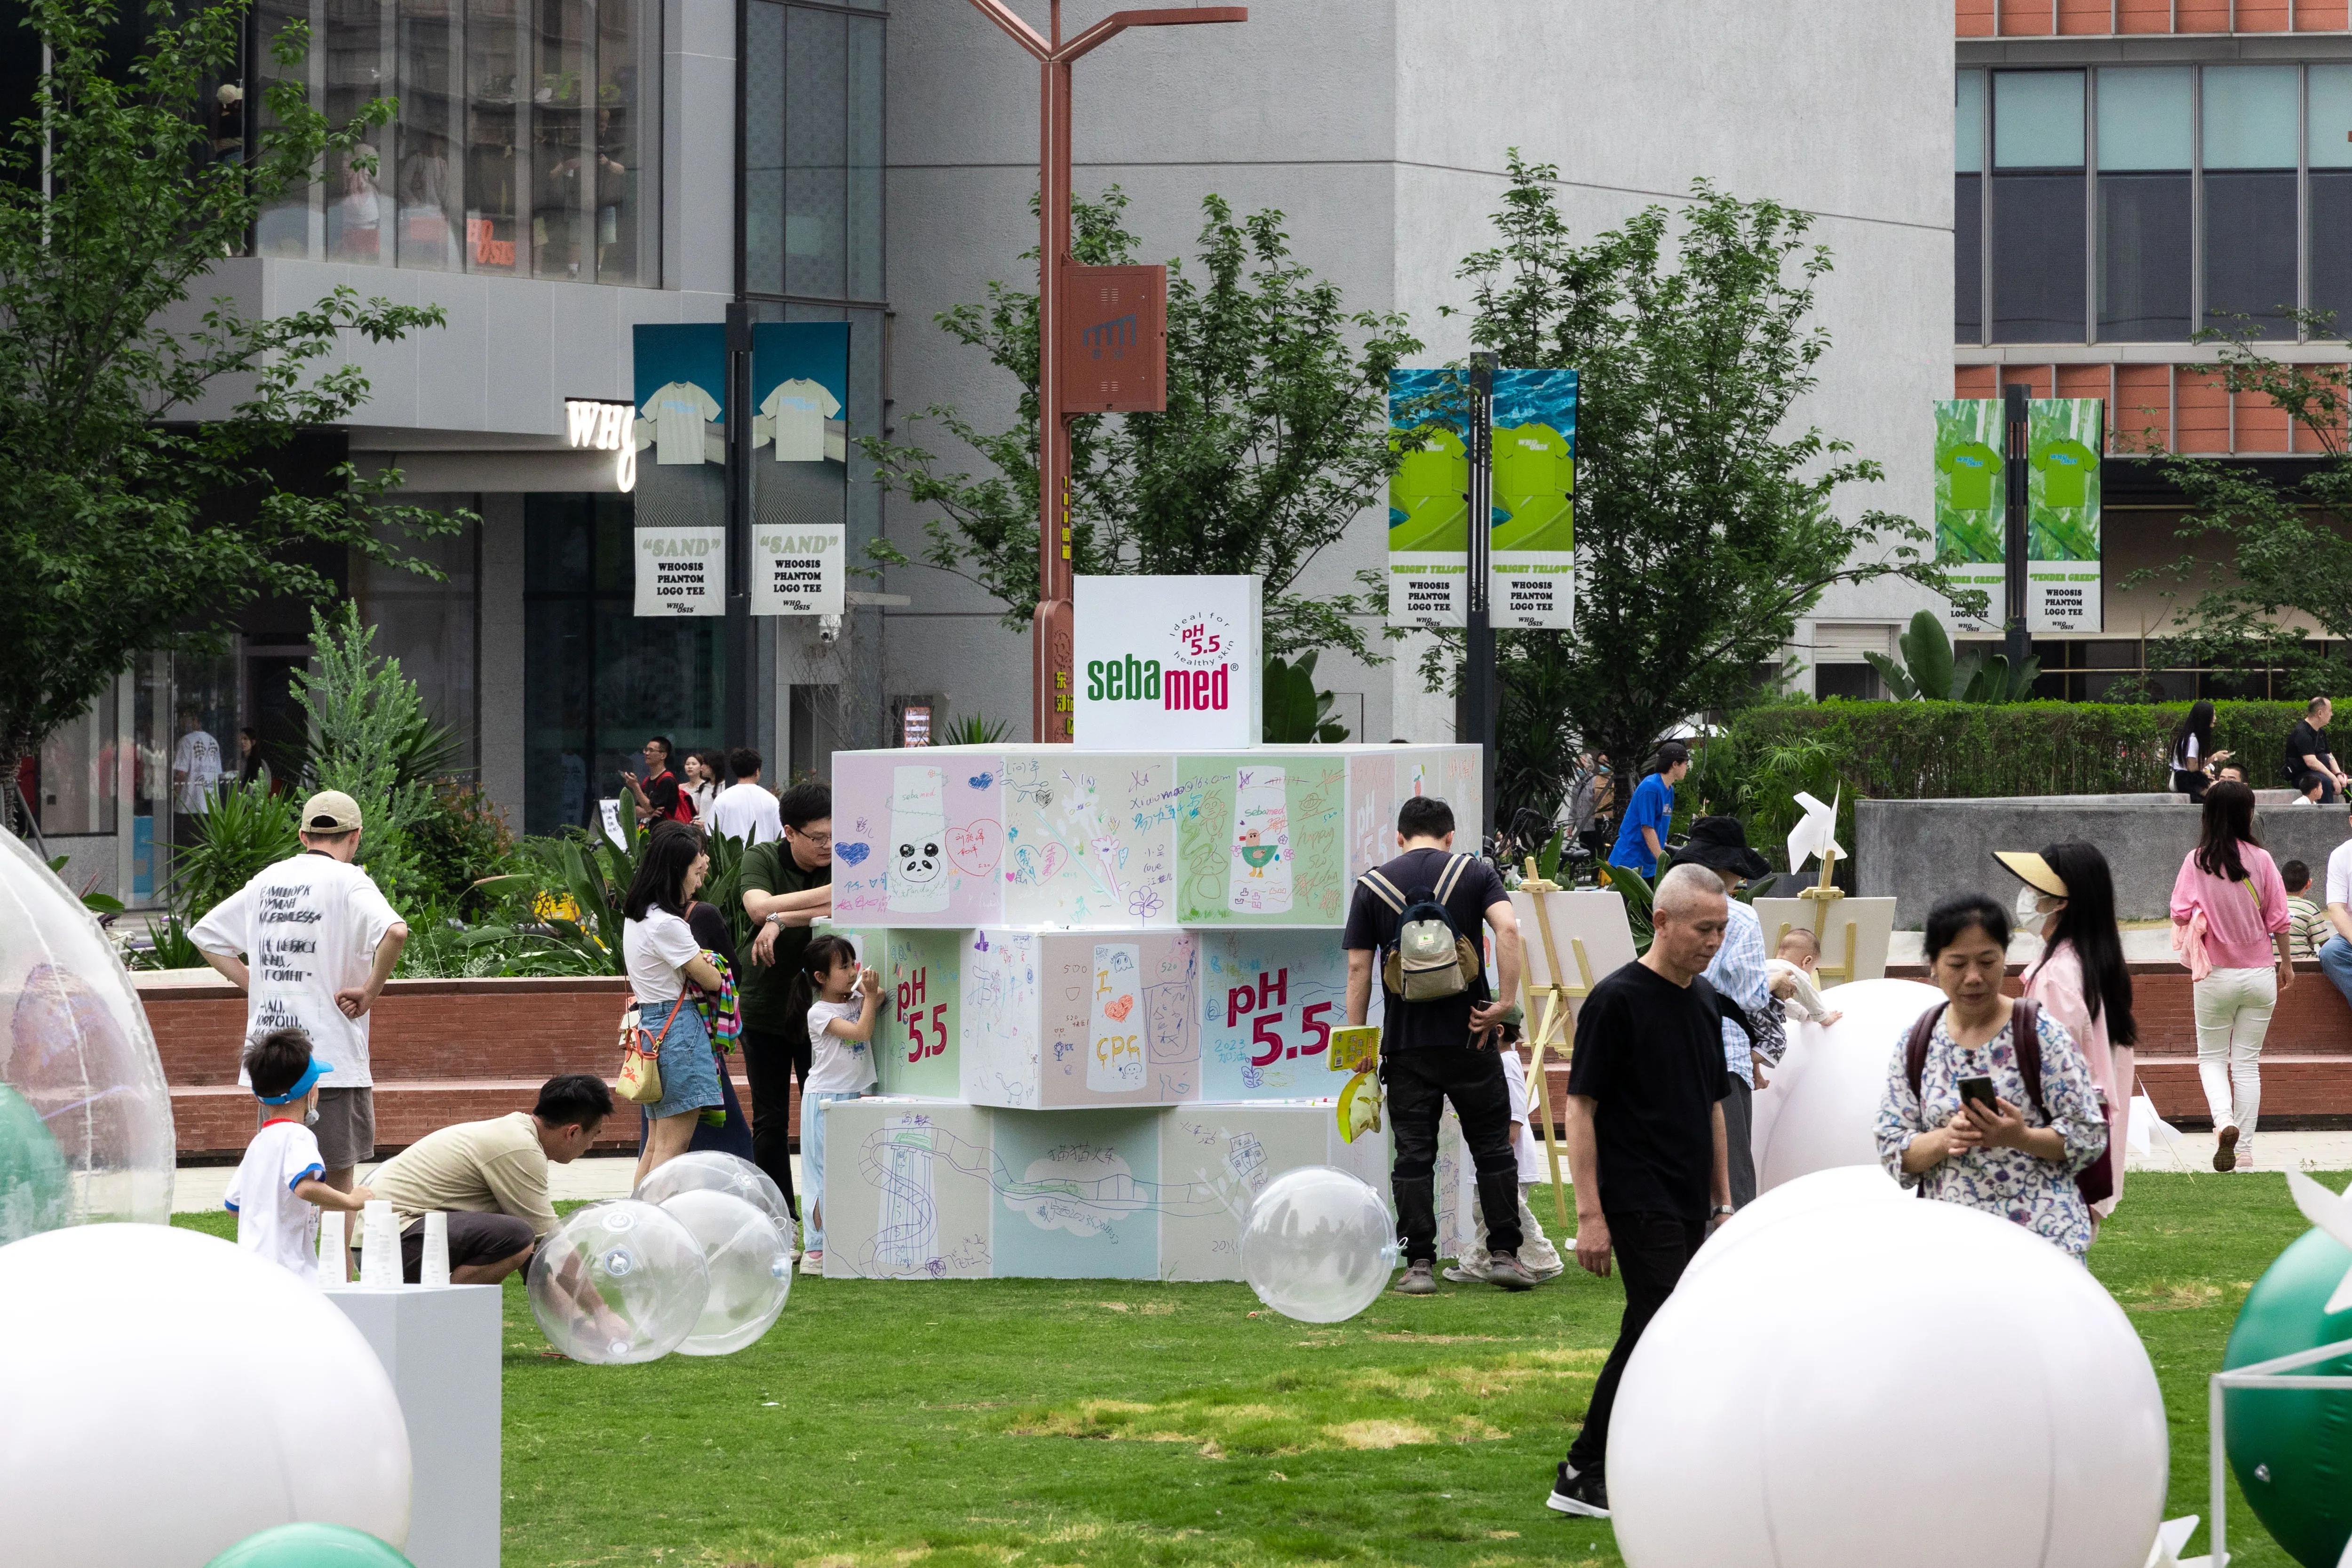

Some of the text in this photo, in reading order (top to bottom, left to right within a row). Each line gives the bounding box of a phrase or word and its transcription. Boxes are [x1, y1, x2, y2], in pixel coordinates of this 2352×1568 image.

[1169, 612, 1230, 636] Ideal for
[1182, 623, 1204, 643] pH
[1174, 640, 1234, 666] healthy skin
[1191, 635, 1220, 655] 5.5
[1245, 804, 1286, 817] sebamed
[1160, 963, 1177, 972] 520
[897, 966, 926, 1022] pH
[1227, 967, 1287, 1028] pH
[908, 1003, 947, 1063] 5.5
[1252, 1001, 1332, 1067] 5.5
[1215, 1039, 1246, 1052] 2023
[1219, 1051, 1246, 1063] 加油
